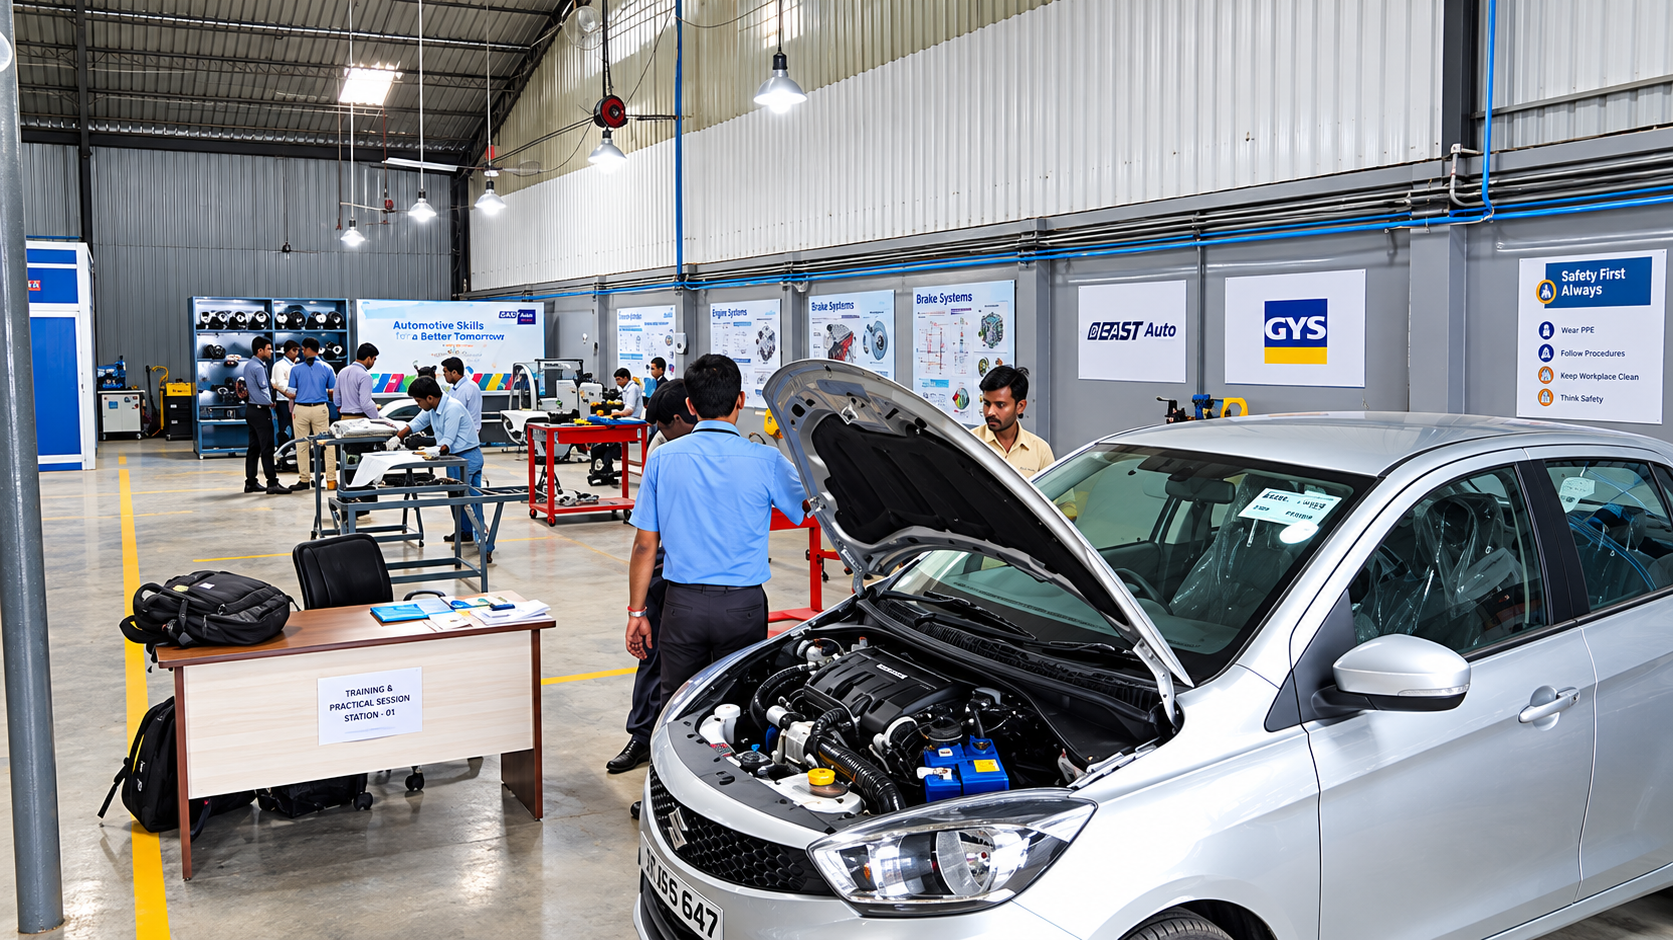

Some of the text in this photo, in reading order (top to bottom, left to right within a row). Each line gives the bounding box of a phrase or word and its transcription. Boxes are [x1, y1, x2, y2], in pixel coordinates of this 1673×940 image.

[1561, 268, 1626, 283] Safety First
[1561, 284, 1603, 298] Always
[916, 292, 973, 306] Brake Systems
[393, 321, 484, 330] Automotive Skills
[1144, 322, 1177, 337] Auto
[1264, 316, 1327, 341] GYS
[421, 332, 452, 341] Better
[1584, 350, 1626, 358] Procedures
[1560, 372, 1639, 381] Keep Workplace Clean
[1560, 394, 1604, 404] Think Safety
[345, 684, 393, 697] TRAINING &
[329, 694, 410, 711] PRACTICAL SESSION
[344, 711, 379, 722] STATION
[385, 709, 396, 717] 01
[682, 889, 718, 939] 647
